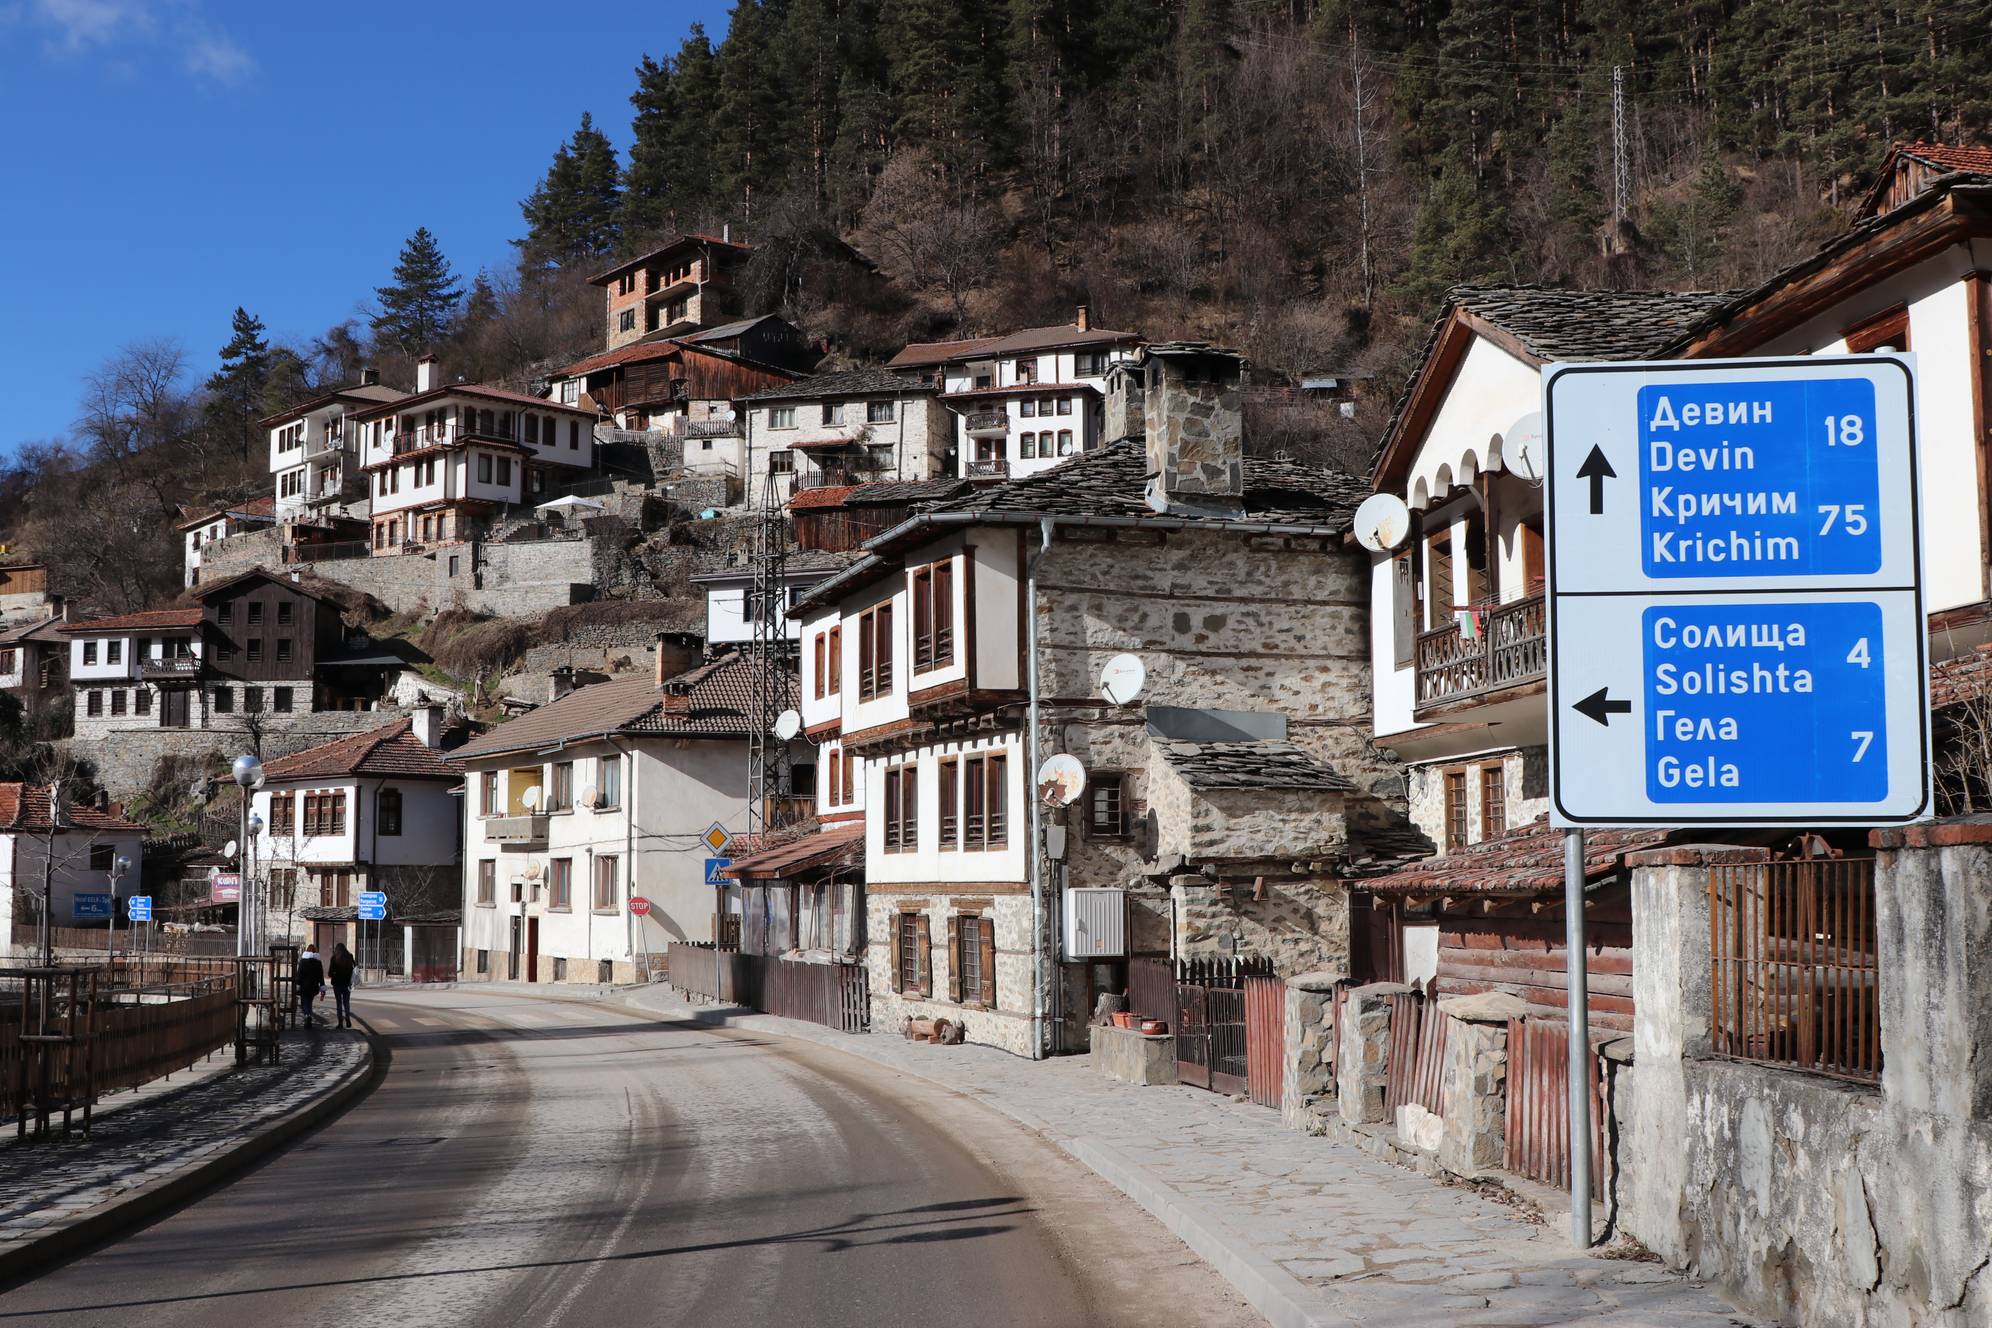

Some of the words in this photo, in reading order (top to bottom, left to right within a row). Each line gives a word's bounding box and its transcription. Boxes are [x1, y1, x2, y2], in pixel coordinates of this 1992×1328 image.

[1649, 396, 1773, 432] Девин
[1824, 414, 1864, 447] 18
[1650, 440, 1754, 472] Devin
[1651, 486, 1797, 525] Кричим
[1817, 504, 1868, 536] 75
[1652, 530, 1799, 563] Krichim
[1653, 616, 1806, 652] Солища
[1845, 637, 1871, 669] 4
[1655, 662, 1813, 695] Solishta
[1656, 709, 1738, 742] Гела
[1850, 731, 1874, 763] 7
[1657, 755, 1740, 788] Gela
[630, 902, 648, 910] STOP
